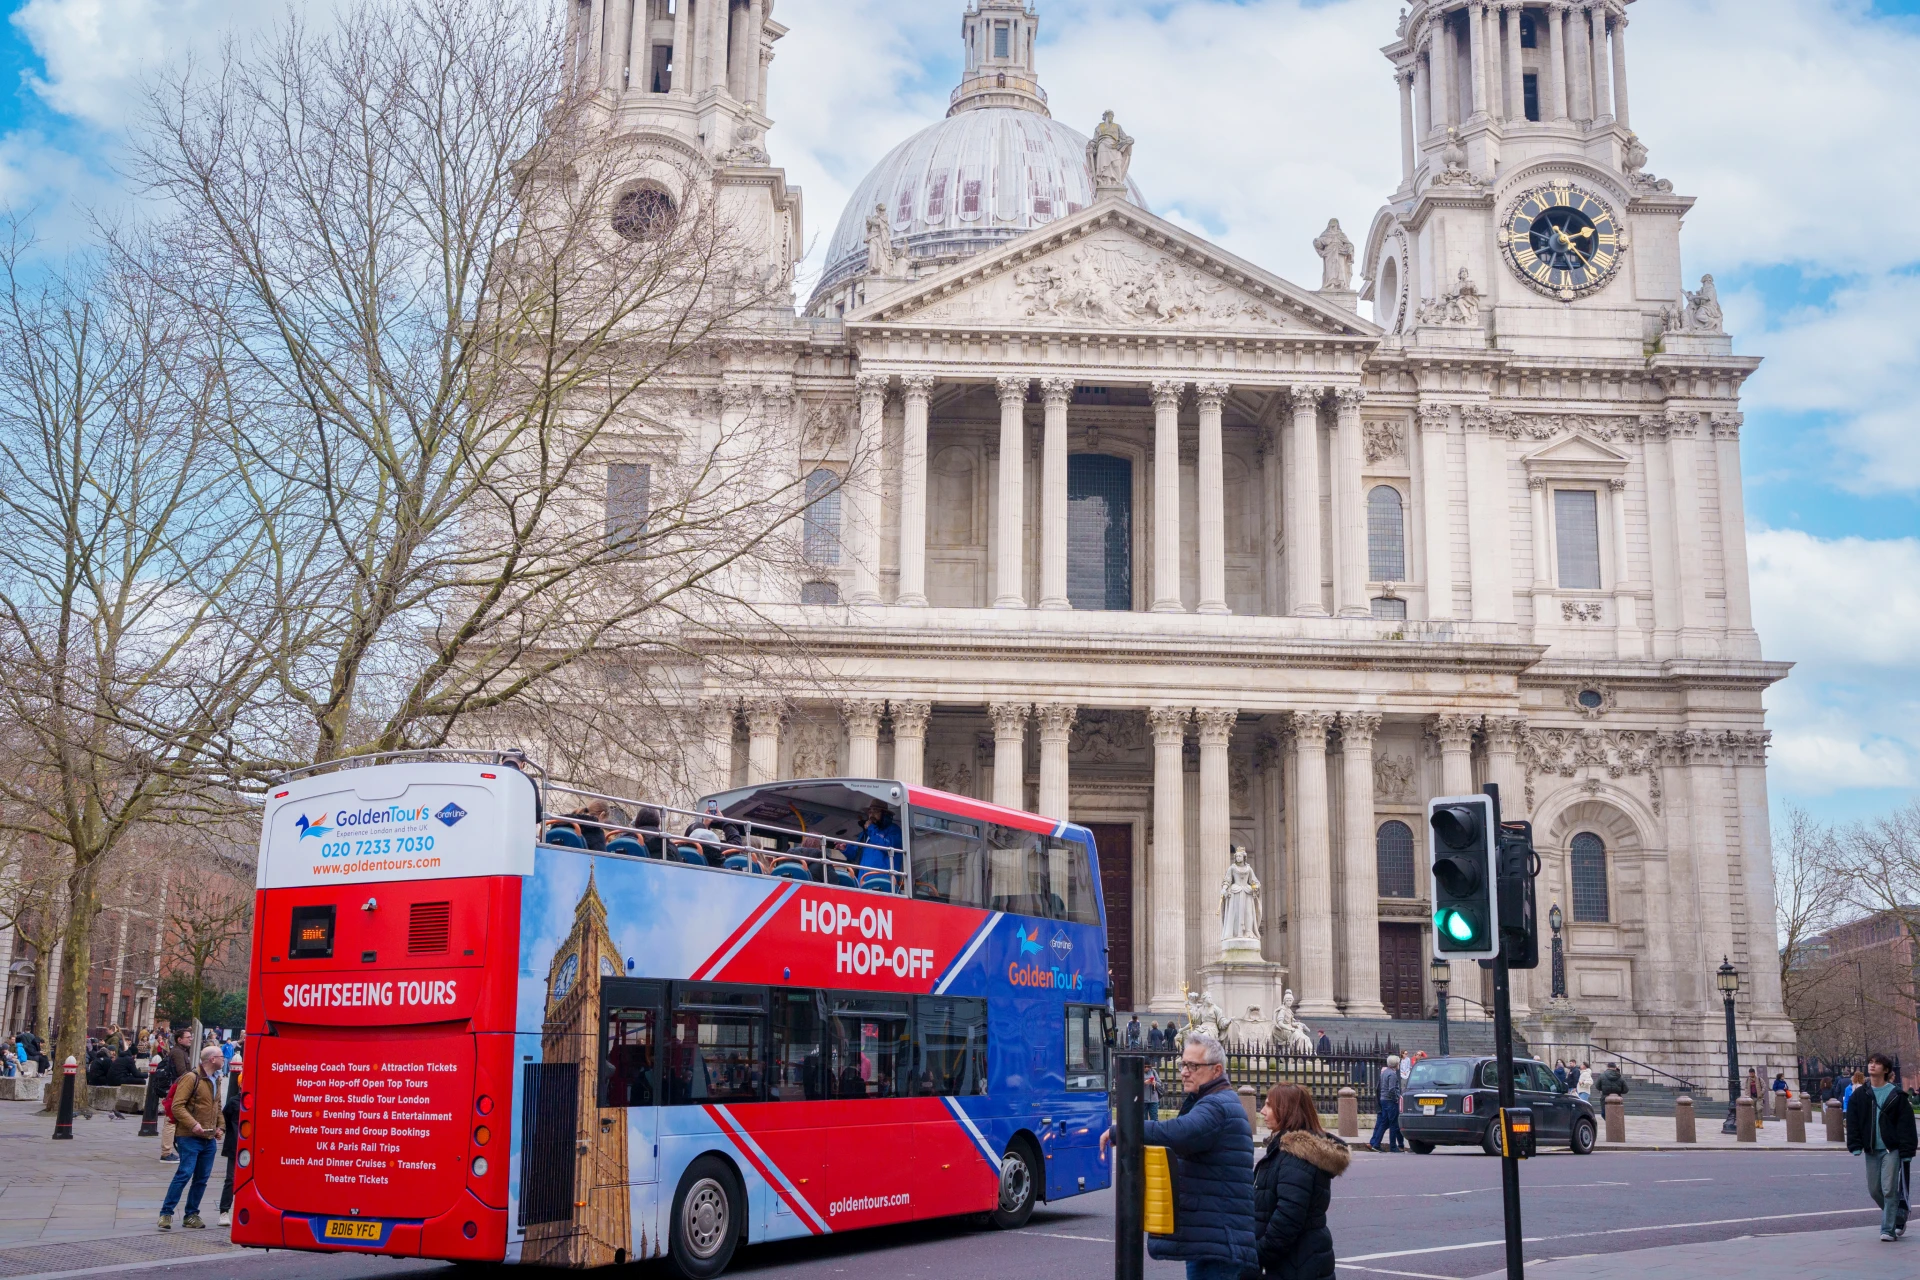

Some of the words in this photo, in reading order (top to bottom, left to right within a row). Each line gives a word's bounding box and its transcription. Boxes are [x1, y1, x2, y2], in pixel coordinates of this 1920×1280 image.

[336, 804, 429, 827] GoldenTours
[336, 830, 368, 838] Experience
[419, 824, 428, 832] UK
[322, 842, 351, 858] 020
[355, 839, 391, 856] 7233
[396, 836, 435, 853] 7030
[313, 856, 441, 875] www.goldentours.com
[801, 899, 893, 941] HOP-ON
[836, 941, 934, 979] HOP-OFF
[1009, 962, 1083, 991] GoldenTours
[283, 981, 393, 1007] SIGHTSEEING
[397, 980, 457, 1006] TOURS
[272, 1063, 317, 1073] Sightseeing
[321, 1063, 345, 1072] Coach
[348, 1063, 370, 1072] Tours
[381, 1063, 424, 1072] Attraction
[426, 1063, 457, 1072] Tickets
[297, 1079, 326, 1089] Hop-on
[329, 1079, 360, 1089] Hop-off
[362, 1079, 384, 1089] Open
[387, 1079, 402, 1089] Top
[405, 1079, 428, 1088] Tours
[294, 1094, 322, 1103] Warner
[325, 1095, 345, 1103] Bros.
[348, 1095, 374, 1104] Studio
[377, 1095, 395, 1104] Tour
[398, 1095, 429, 1104] London
[272, 1110, 288, 1118] Bike
[291, 1110, 312, 1119] Tours
[324, 1110, 355, 1121] Evening
[358, 1111, 380, 1120] Tours
[383, 1111, 388, 1120] &
[392, 1111, 452, 1121] Entertainment
[290, 1126, 317, 1135] Private
[321, 1126, 342, 1135] Tours
[345, 1127, 360, 1135] and
[363, 1127, 388, 1138] Group
[391, 1128, 430, 1139] Bookings
[1512, 1124, 1531, 1133] WAIT
[317, 1142, 328, 1151] UK
[330, 1142, 335, 1151] &
[339, 1142, 358, 1151] Paris
[361, 1143, 376, 1152] Rail
[380, 1144, 399, 1154] Trips
[281, 1157, 304, 1166] Lunch
[307, 1158, 323, 1166] And
[327, 1158, 353, 1167] Dinner
[356, 1159, 386, 1169] Cruises
[398, 1160, 436, 1170] Transfers
[325, 1174, 356, 1184] Theatre
[359, 1175, 388, 1185] Tickets
[829, 1192, 910, 1216] goldentours.com
[331, 1222, 354, 1236] BD16
[356, 1223, 376, 1237] YFC
